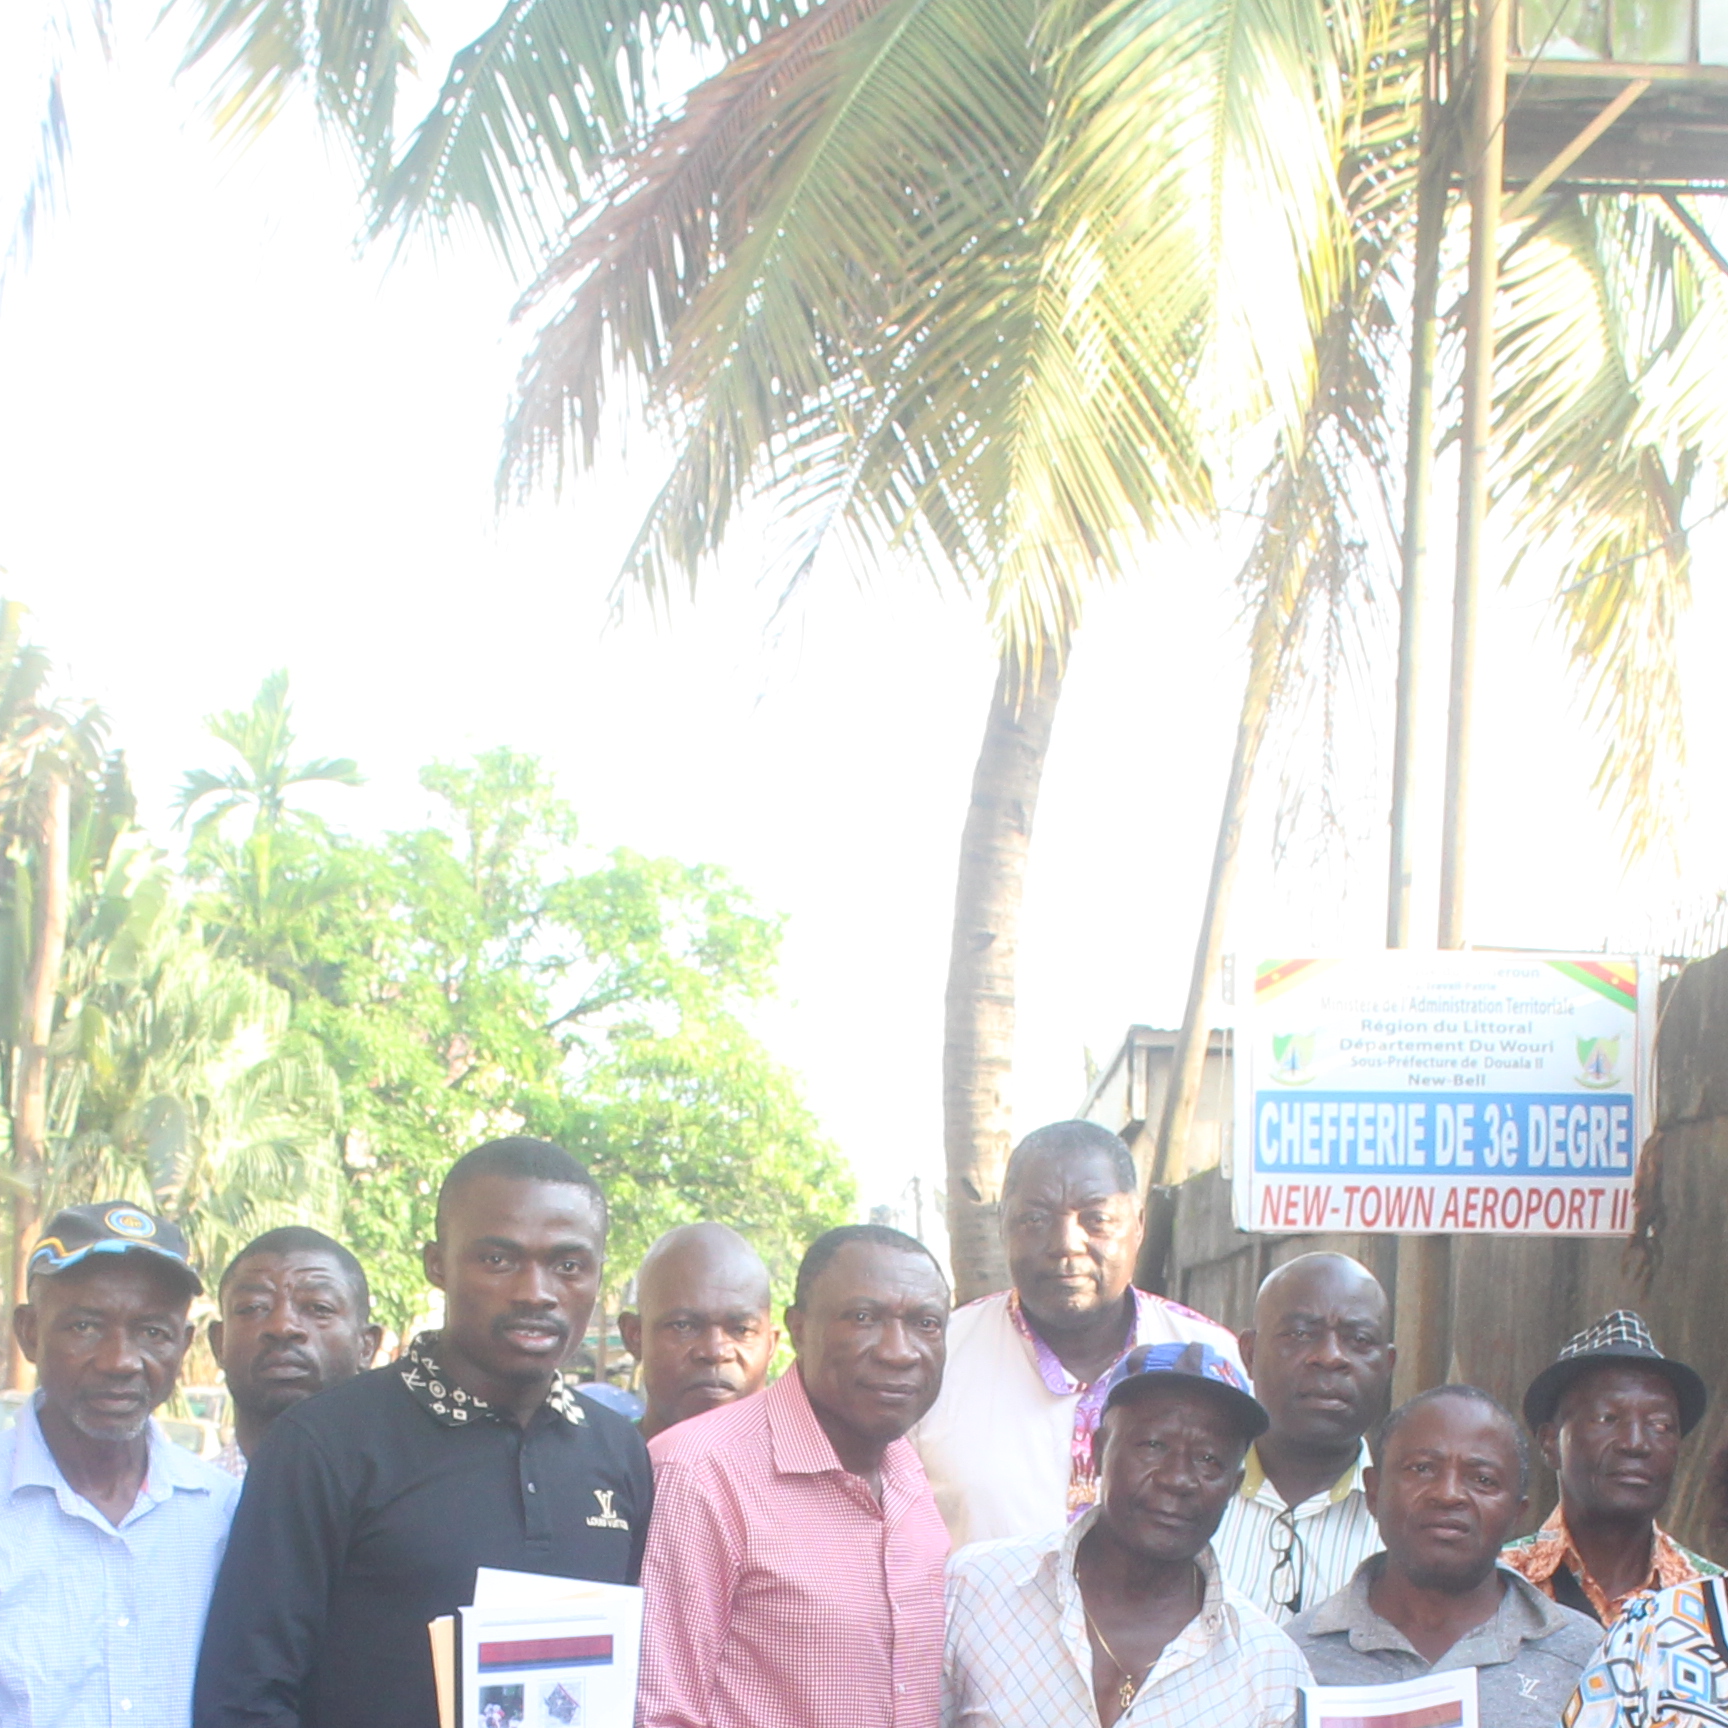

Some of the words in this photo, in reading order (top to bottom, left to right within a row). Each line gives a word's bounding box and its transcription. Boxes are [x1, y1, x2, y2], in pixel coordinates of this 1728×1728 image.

[1382, 998, 1399, 1013] de
[1506, 997, 1575, 1016] Territoriale
[1361, 1019, 1428, 1035] Région
[1434, 1020, 1458, 1034] du
[1463, 1020, 1533, 1034] Littoral
[1339, 1037, 1464, 1054] Département
[1469, 1040, 1495, 1053] Du
[1499, 1040, 1554, 1054] Wouri
[1350, 1056, 1458, 1069] Sous-Préfecture
[1461, 1056, 1478, 1069] de
[1484, 1057, 1532, 1069] Douala
[1535, 1057, 1544, 1069] II
[1408, 1074, 1486, 1087] New-Bell
[1259, 1101, 1426, 1166] CHEFFERIE
[1435, 1103, 1475, 1166] DE
[1483, 1103, 1519, 1168] 3è
[1527, 1104, 1628, 1168] DEGRE
[1260, 1184, 1435, 1228] NEW-TOWN
[1439, 1187, 1606, 1229] AEROPORT
[1610, 1188, 1630, 1230] II
